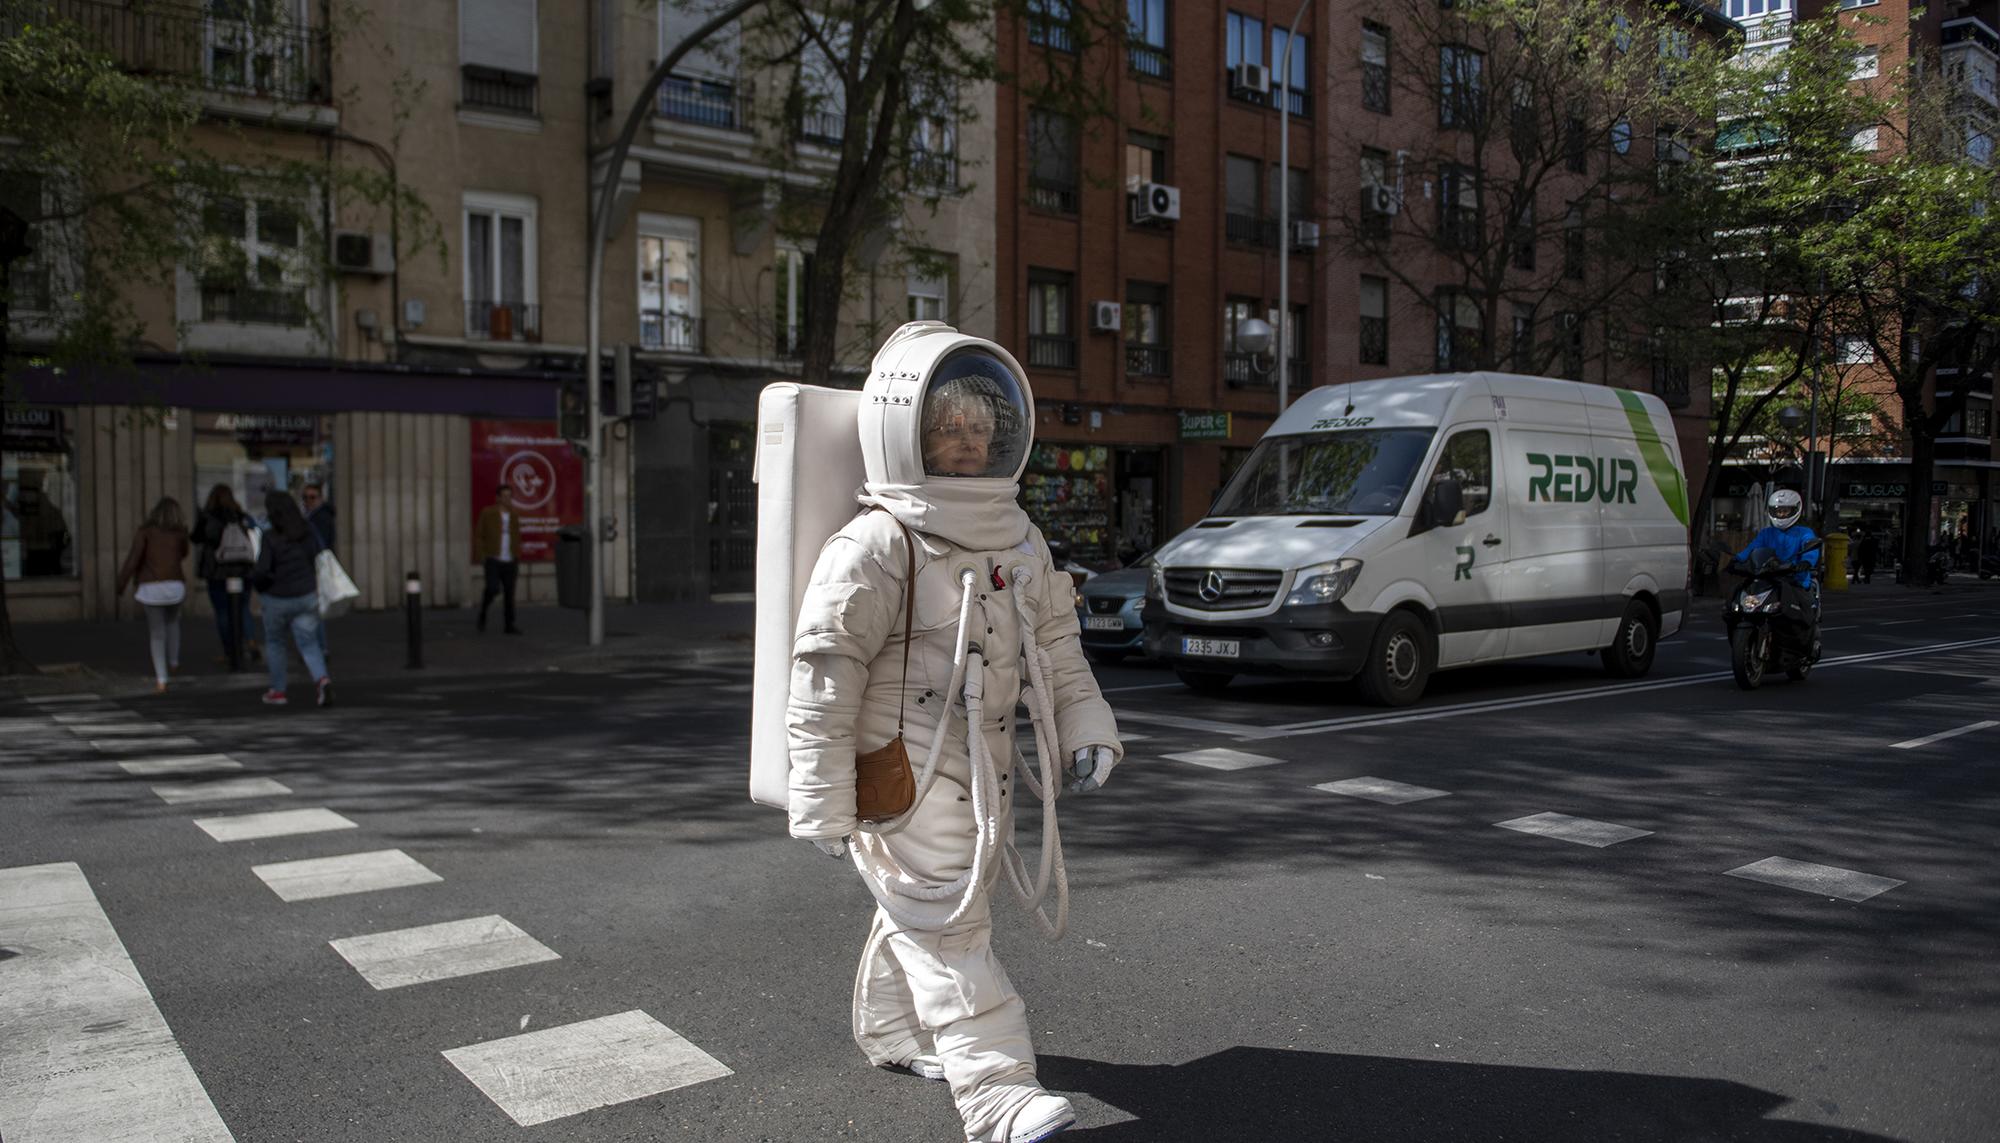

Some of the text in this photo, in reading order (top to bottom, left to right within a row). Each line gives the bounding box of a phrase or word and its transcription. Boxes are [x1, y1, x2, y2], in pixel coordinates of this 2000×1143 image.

[1181, 414, 1214, 430] SUPER
[1312, 416, 1374, 430] REDUR
[1526, 452, 1639, 504] REDUR
[1848, 484, 1904, 496] DOUGLAS
[1454, 546, 1475, 581] R
[1189, 641, 1237, 656] 2335 JXJ
